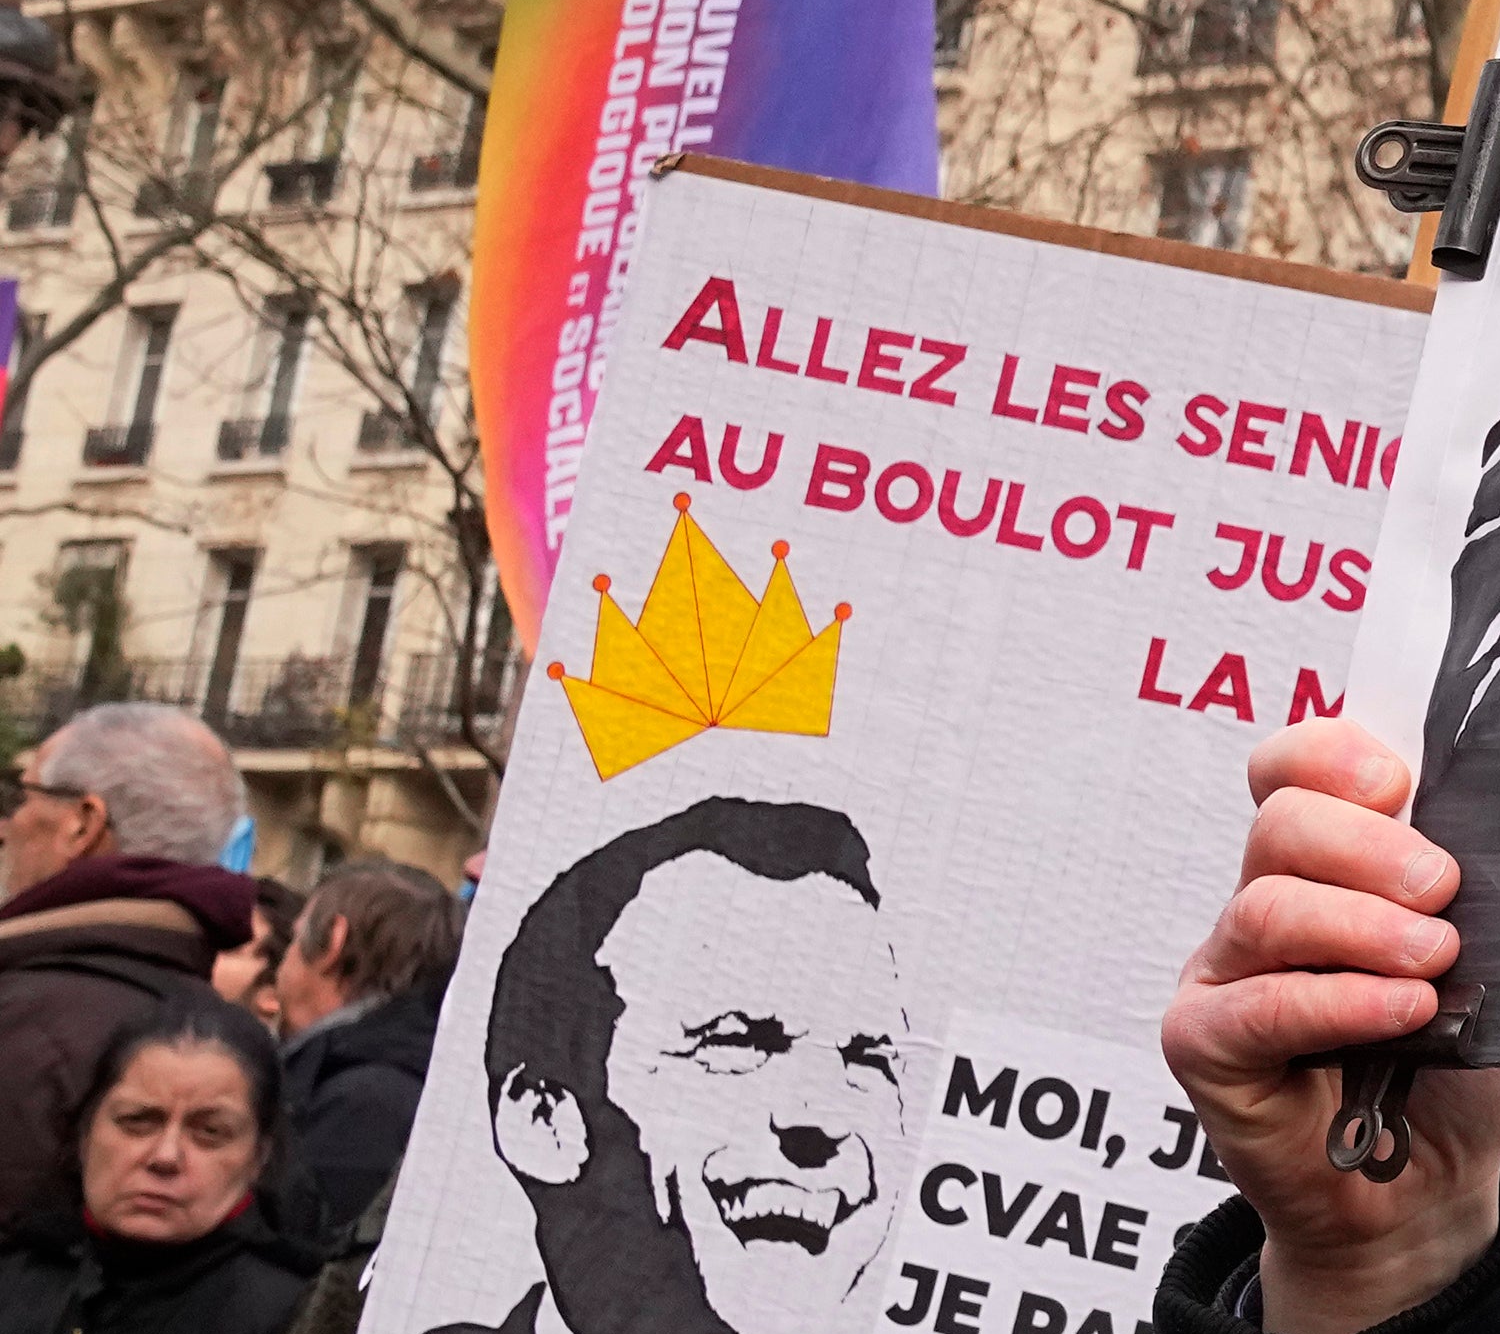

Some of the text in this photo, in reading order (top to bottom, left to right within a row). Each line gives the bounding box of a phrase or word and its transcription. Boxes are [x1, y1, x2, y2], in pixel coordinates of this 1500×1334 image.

[663, 277, 1401, 489] ALLEZ LES SENI
[645, 415, 784, 490] AU
[805, 444, 1175, 570] BOULOT
[1139, 638, 1254, 722] LA
[943, 1056, 1125, 1168] MOI,
[920, 1164, 1148, 1270] CVAE
